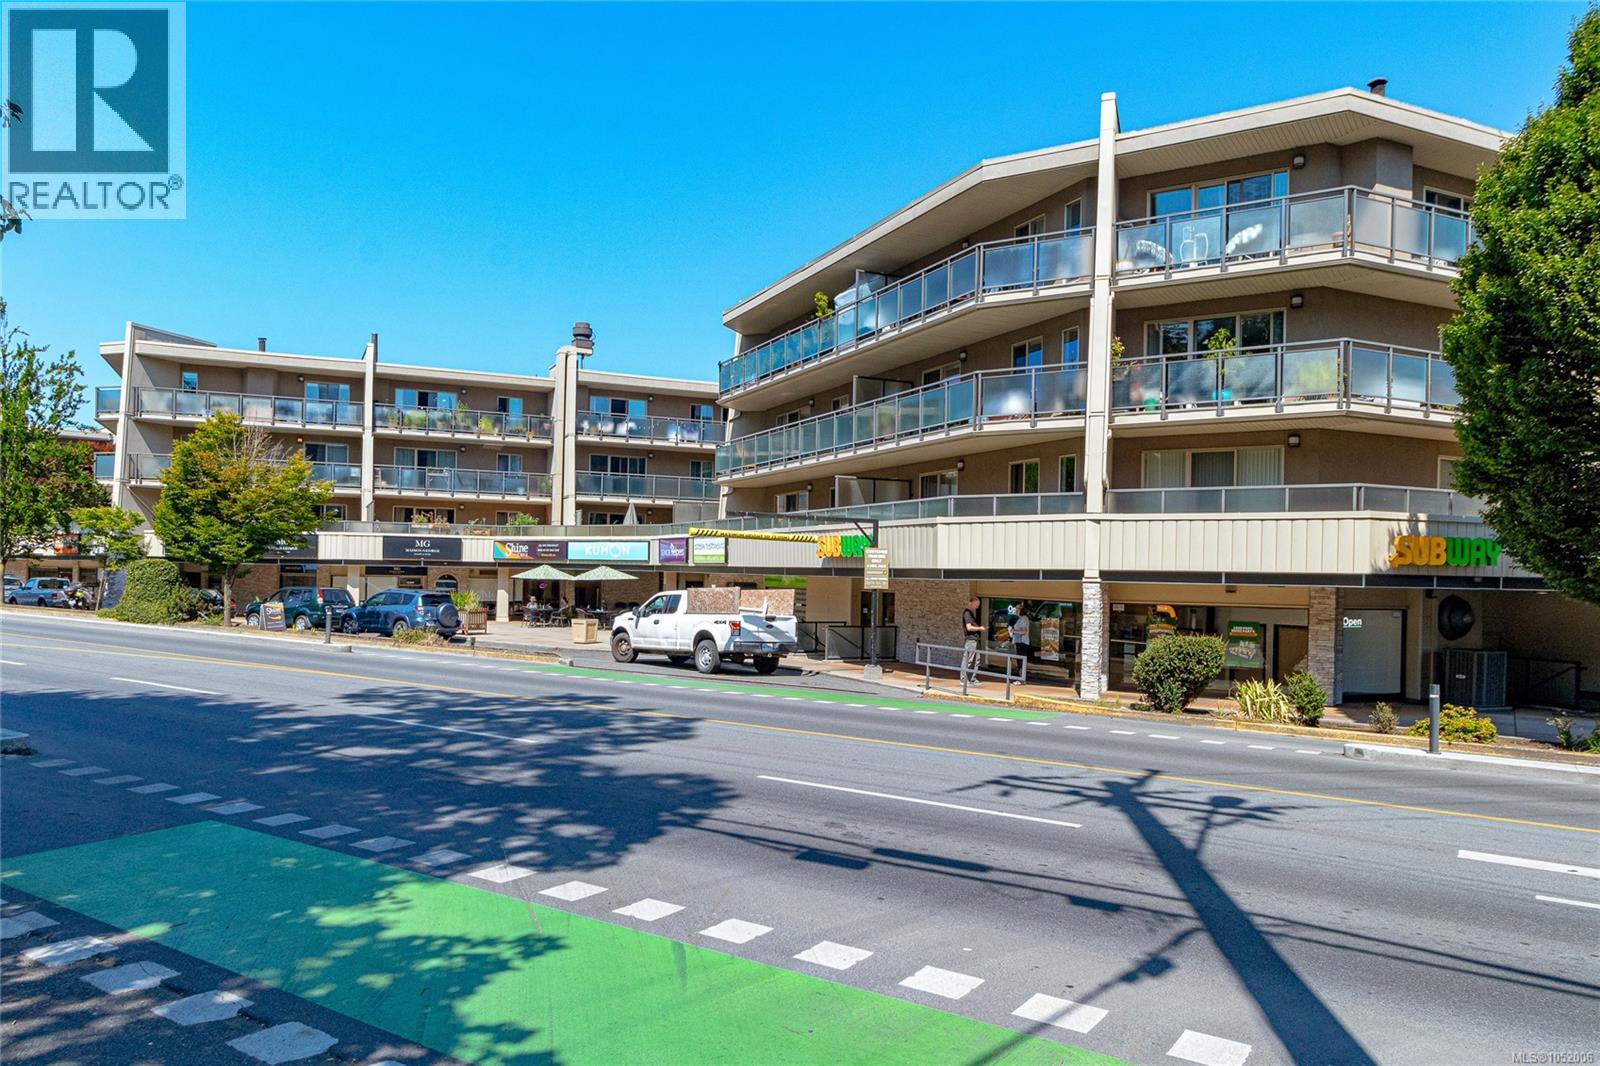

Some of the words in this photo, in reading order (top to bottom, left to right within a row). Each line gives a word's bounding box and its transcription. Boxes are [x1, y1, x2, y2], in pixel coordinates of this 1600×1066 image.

[415, 539, 431, 548] MG
[505, 543, 529, 557] Shine
[585, 543, 630, 557] KUMON
[1388, 535, 1502, 567] SUBWAY
[1343, 616, 1362, 627] Open
